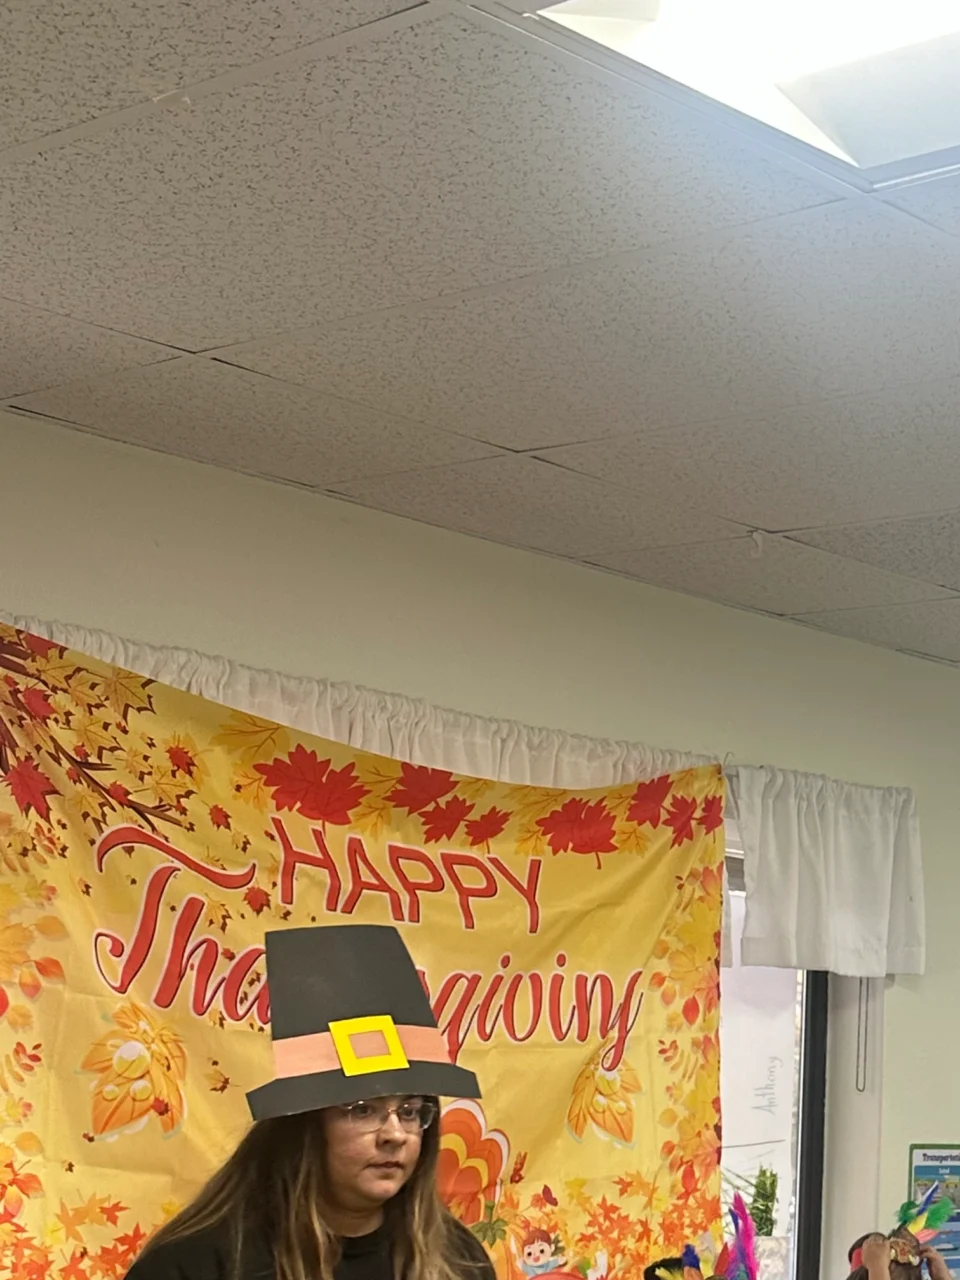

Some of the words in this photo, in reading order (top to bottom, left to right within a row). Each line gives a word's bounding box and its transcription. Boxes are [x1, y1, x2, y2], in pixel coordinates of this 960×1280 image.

[269, 815, 541, 934] HAPPY
[94, 824, 644, 1072] Thagiving
[751, 1056, 784, 1116] Anthony
